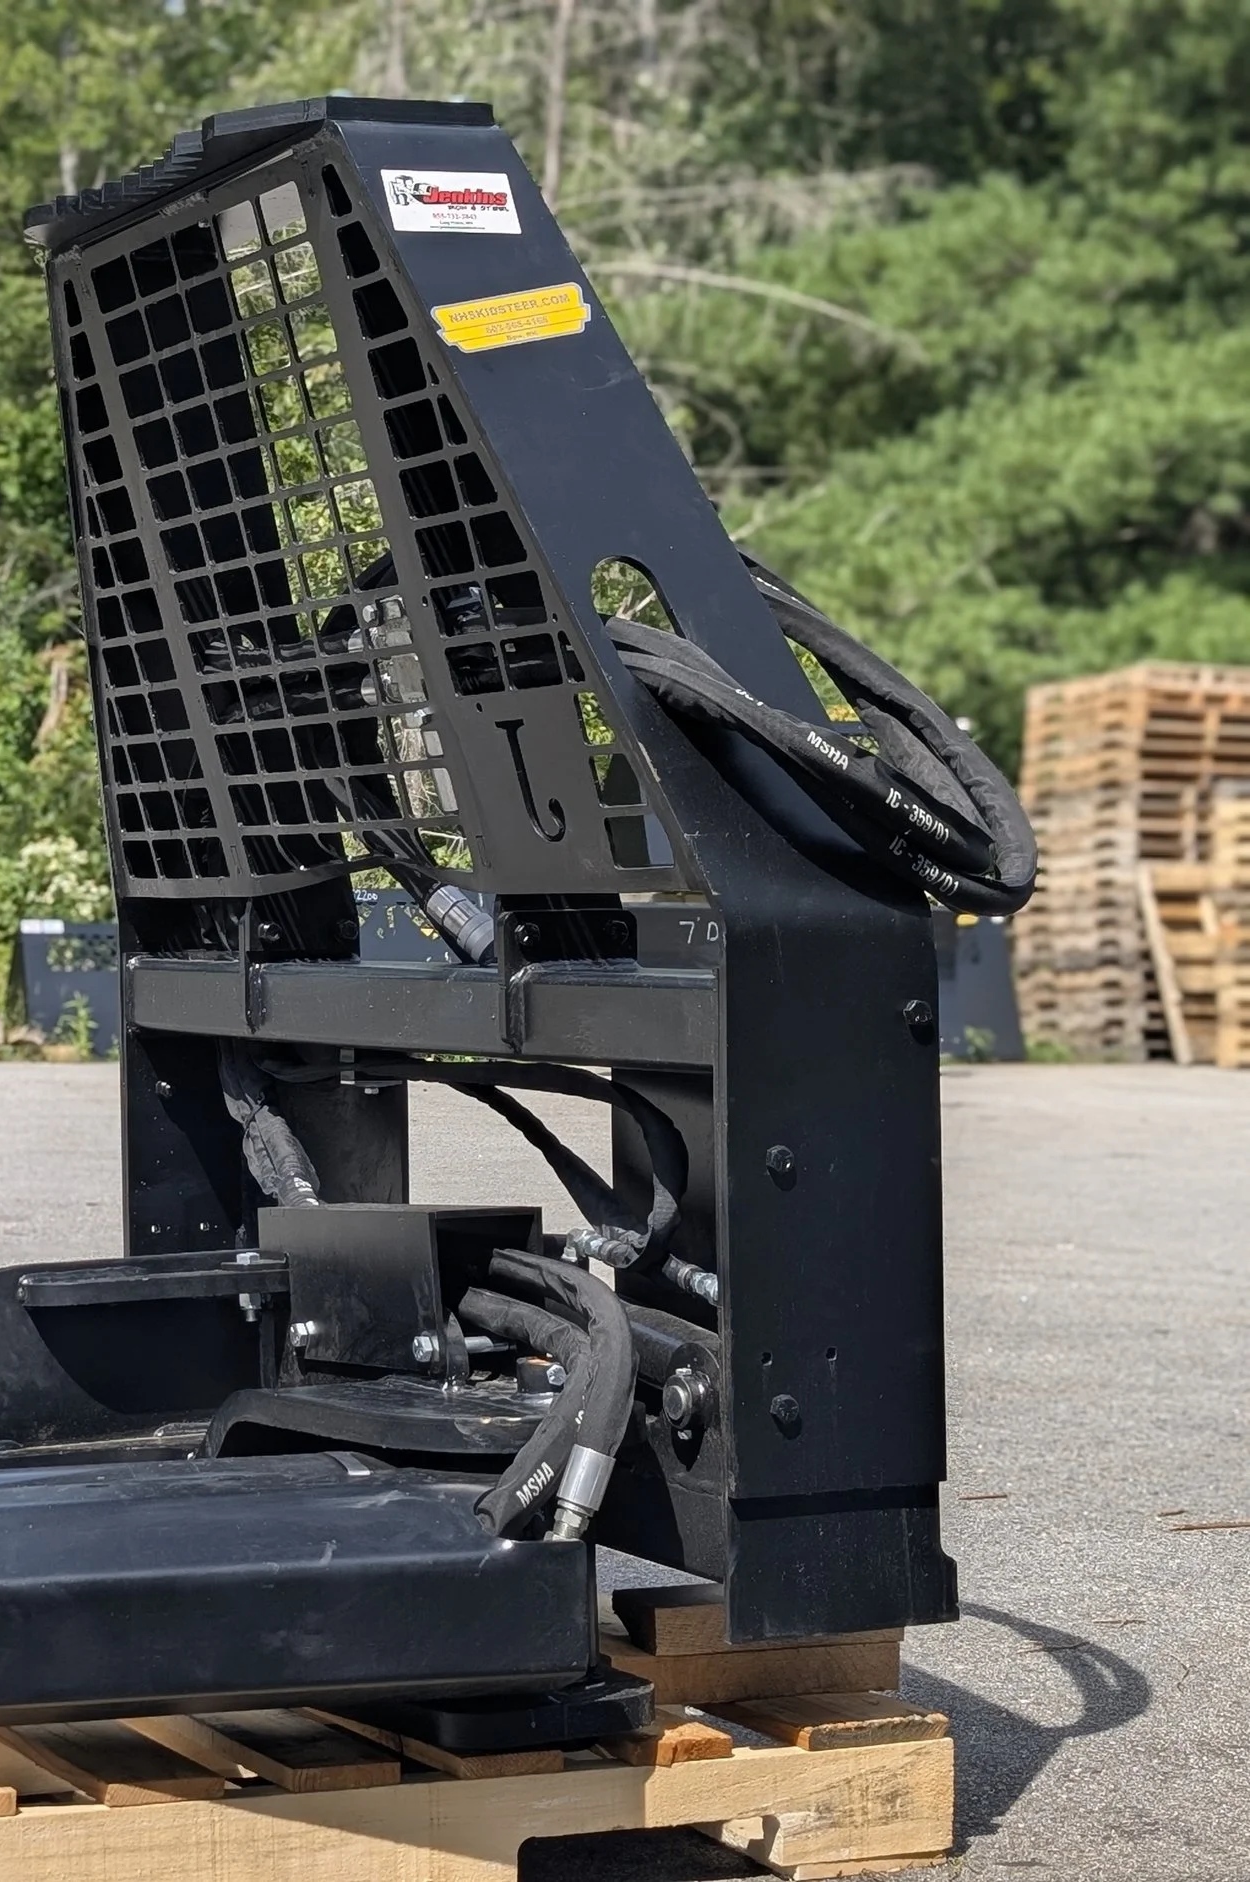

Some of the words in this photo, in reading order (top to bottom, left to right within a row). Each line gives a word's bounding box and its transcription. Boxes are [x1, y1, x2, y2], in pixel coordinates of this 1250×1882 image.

[423, 187, 508, 206] Jenkins
[449, 293, 571, 323] NHSKIDSTEER.COM
[807, 731, 849, 770] MSHA
[352, 889, 378, 901] 2200
[516, 1461, 555, 1508] MSHA
